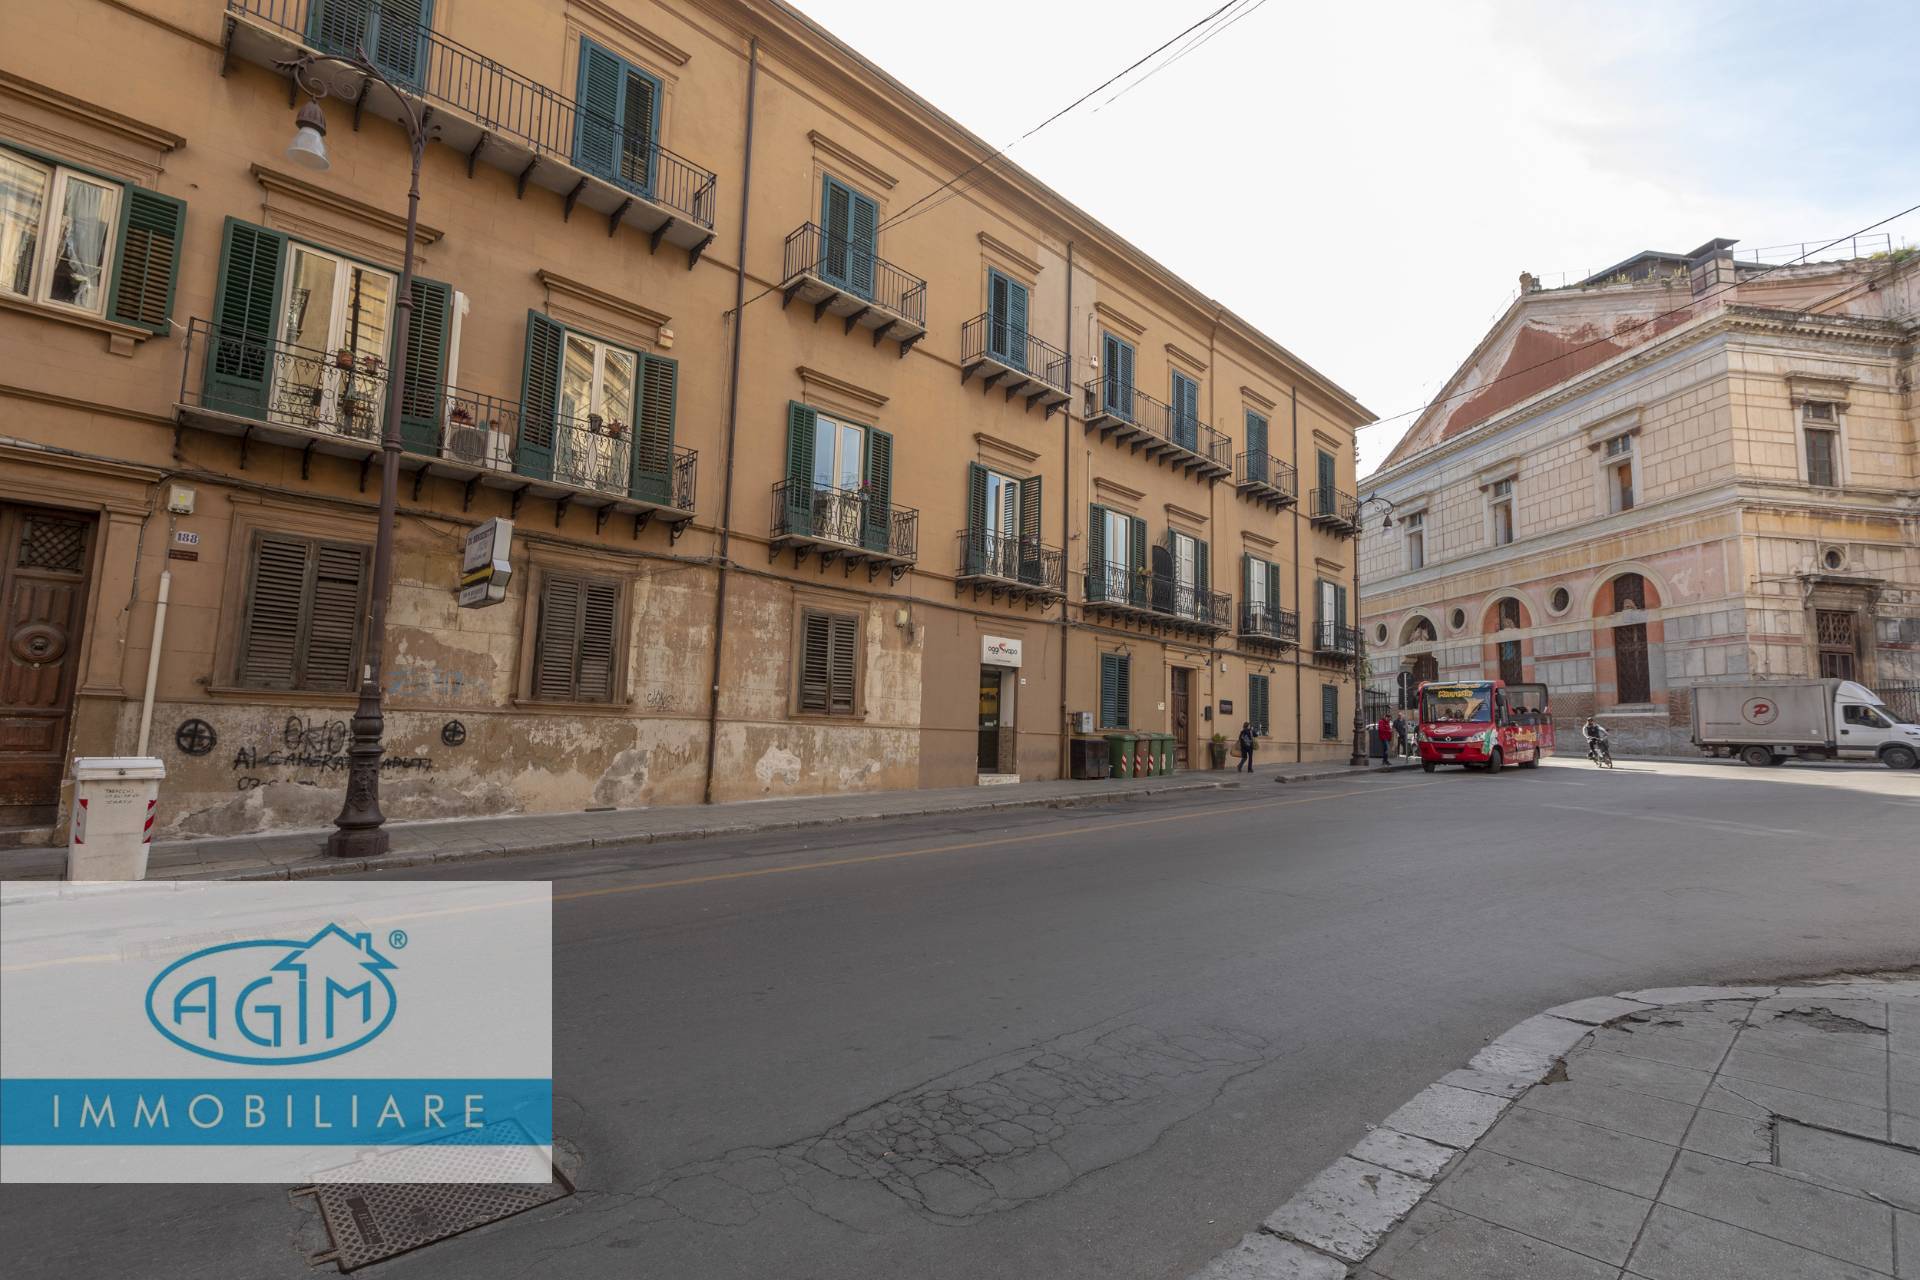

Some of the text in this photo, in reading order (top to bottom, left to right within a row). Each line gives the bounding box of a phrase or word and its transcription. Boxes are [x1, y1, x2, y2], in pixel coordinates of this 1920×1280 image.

[177, 532, 198, 544] 188
[262, 750, 351, 772] CAMERAT
[380, 756, 433, 772] ADUTI
